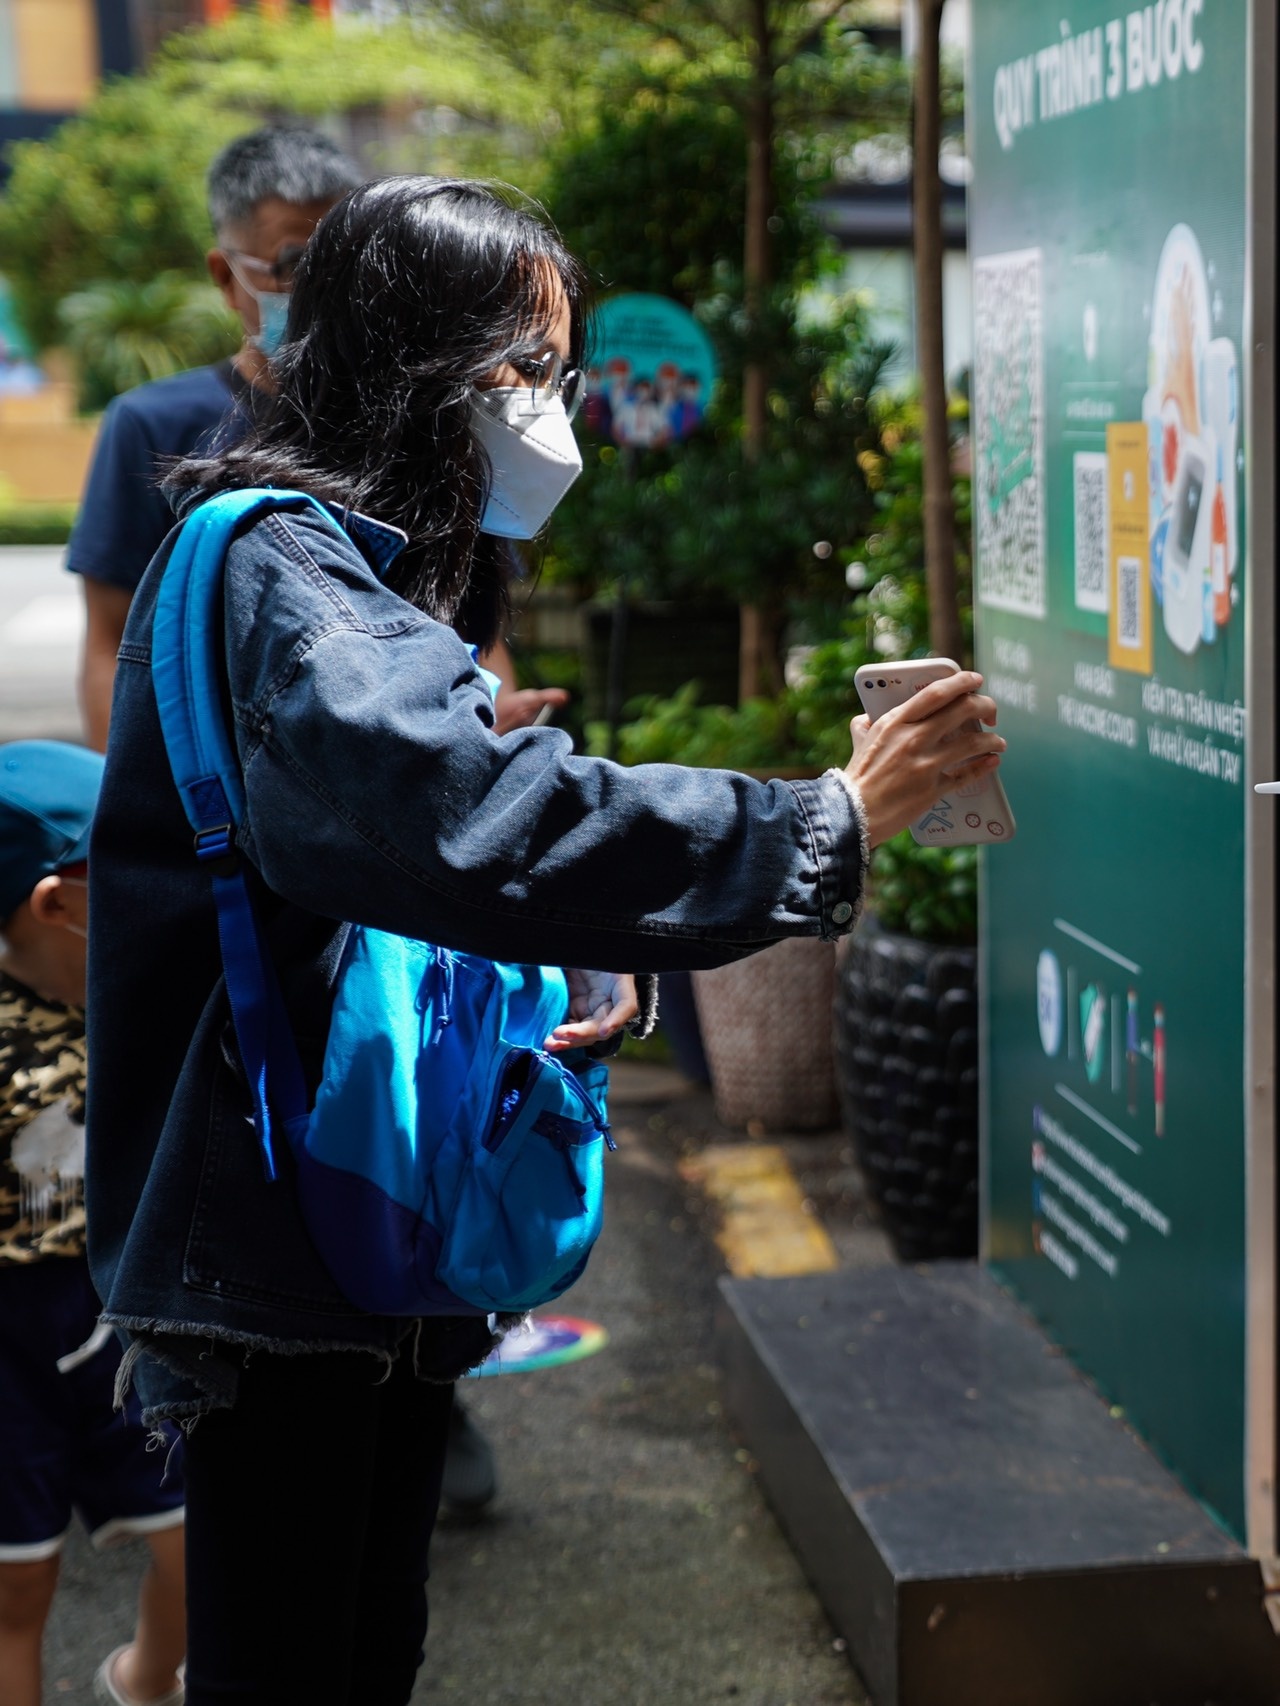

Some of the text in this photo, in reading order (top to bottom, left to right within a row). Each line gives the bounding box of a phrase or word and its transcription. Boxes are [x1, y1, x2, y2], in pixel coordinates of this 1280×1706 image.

[993, 53, 1034, 150] QUY
[1037, 19, 1103, 120] TRÌNH
[1106, 19, 1123, 99] 3
